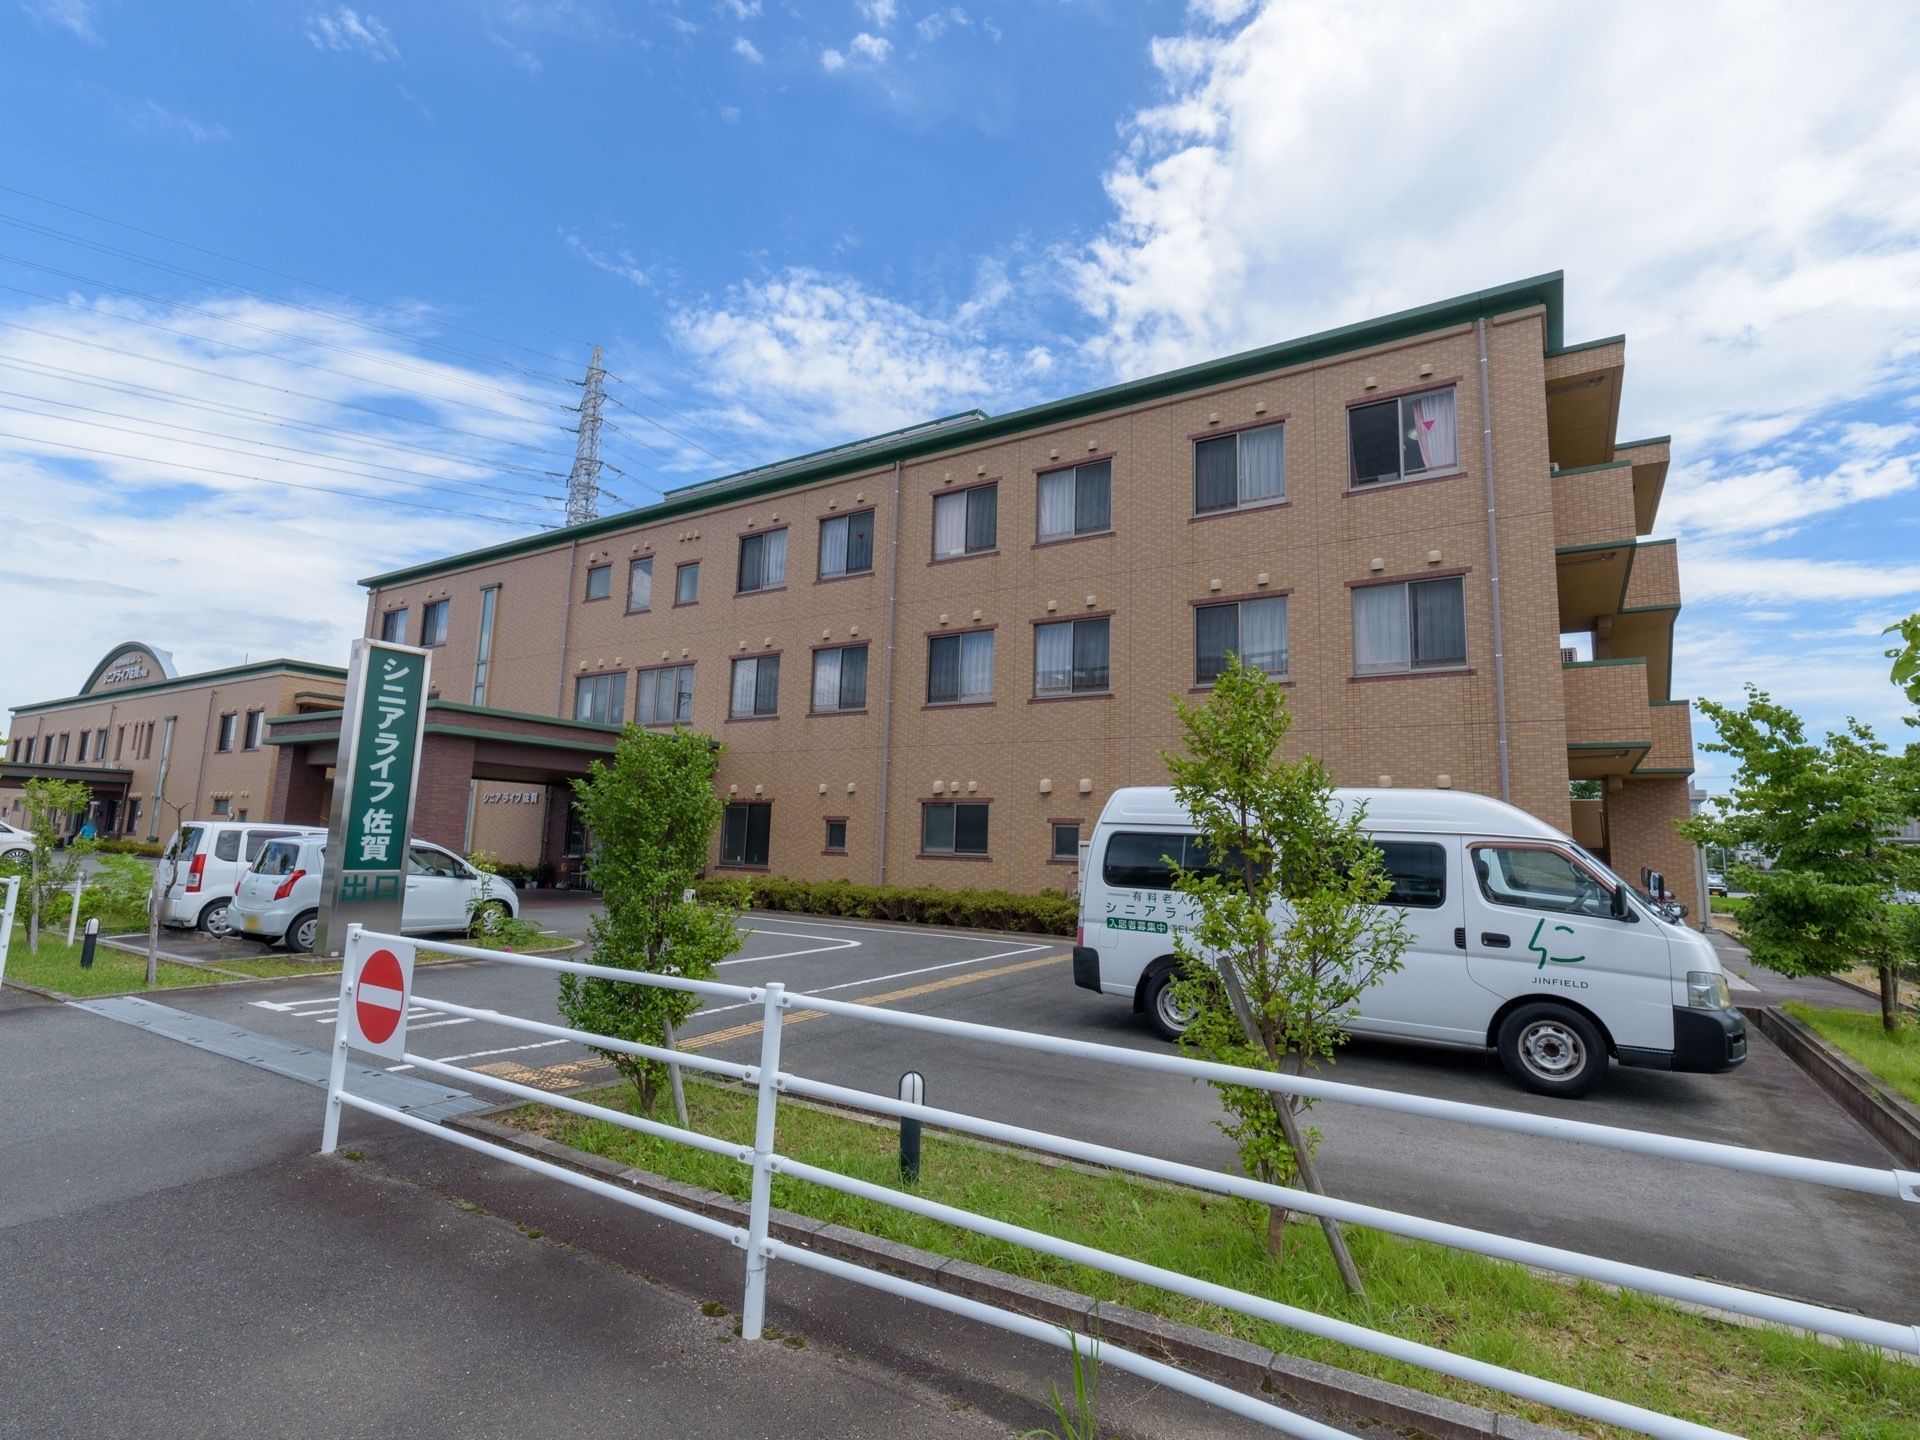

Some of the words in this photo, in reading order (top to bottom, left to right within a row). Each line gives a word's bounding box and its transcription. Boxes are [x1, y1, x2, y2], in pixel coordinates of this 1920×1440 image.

[360, 658, 410, 862] シニアライフ佐賀
[483, 792, 538, 804] シニアライフ佐賀
[341, 875, 399, 903] 出口
[1109, 919, 1166, 933] 入居者募集中
[1532, 976, 1589, 989] JINFIELD
